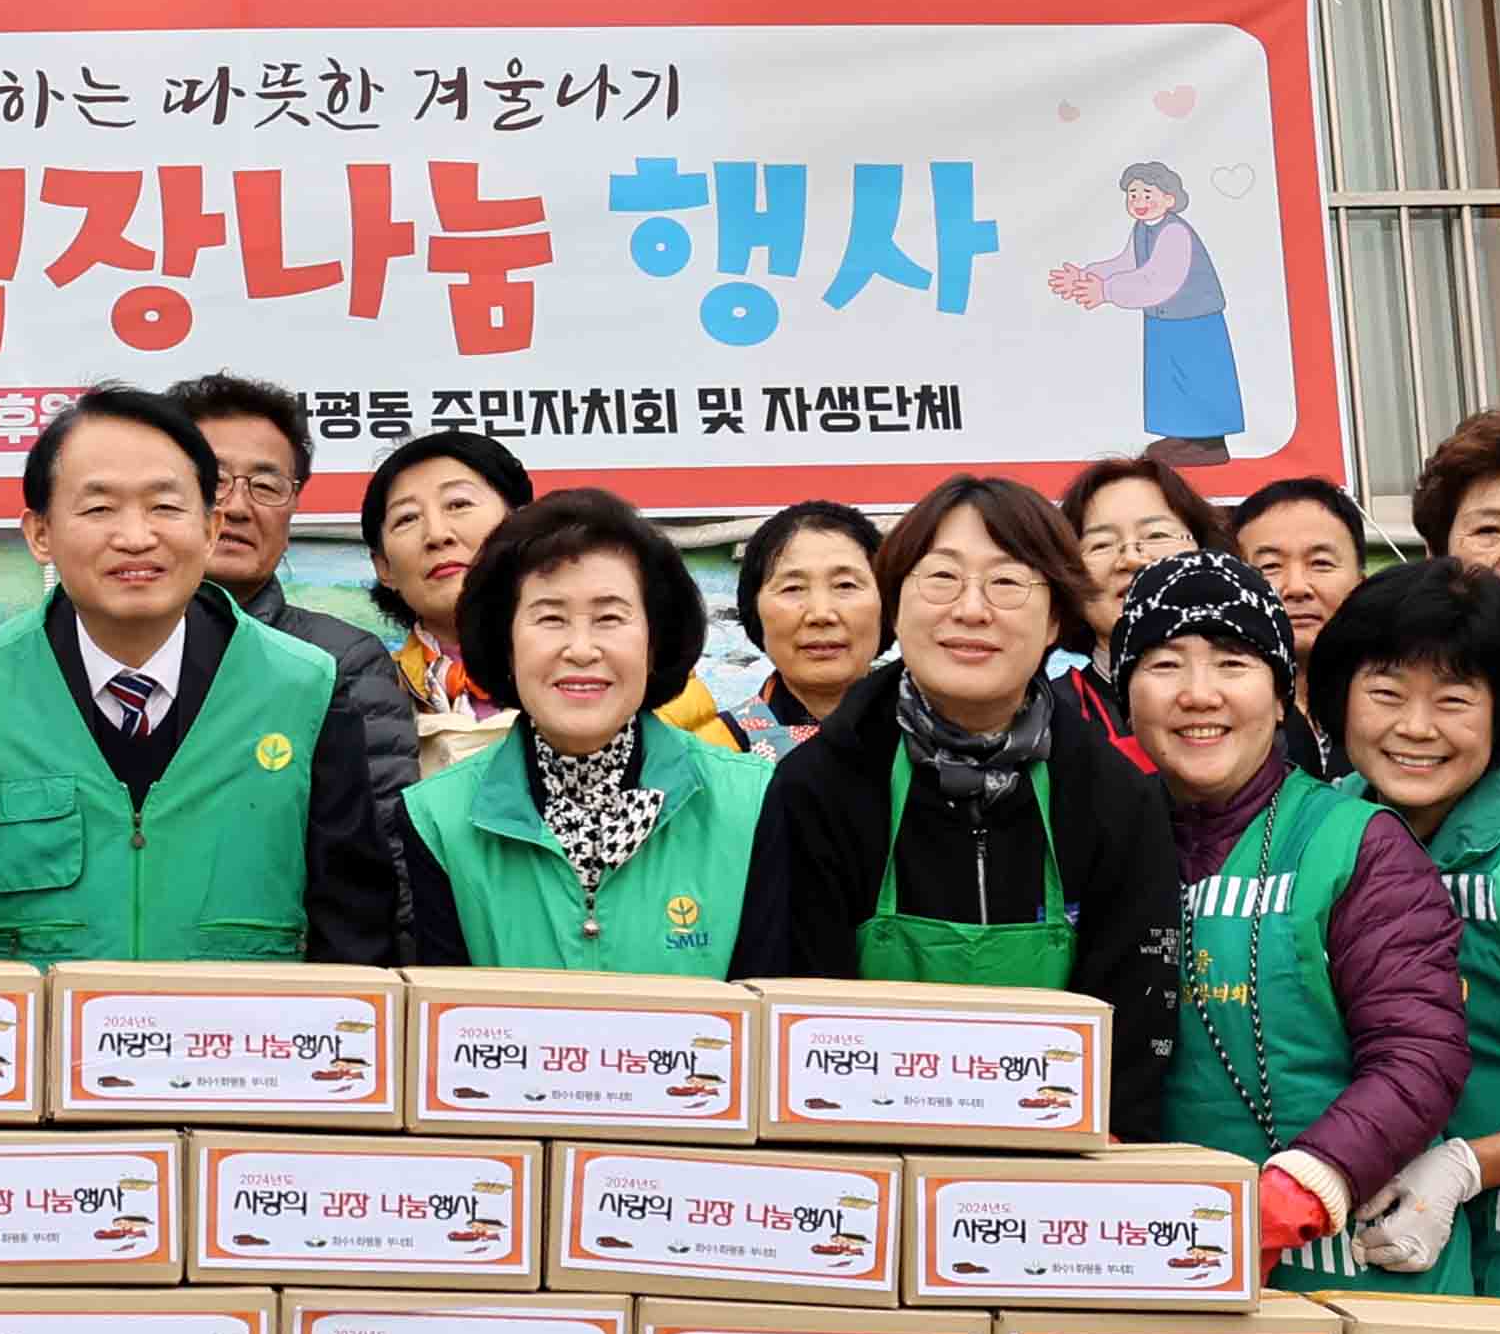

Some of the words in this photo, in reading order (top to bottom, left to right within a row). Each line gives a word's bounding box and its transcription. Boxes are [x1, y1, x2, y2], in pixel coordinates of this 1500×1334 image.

[163, 57, 385, 131] 따뜻한
[414, 57, 681, 131] 겨울나기
[608, 157, 1001, 348] 행사
[431, 388, 678, 438] 주민자치회
[697, 386, 746, 435] 및
[761, 384, 963, 434] 자생단체
[98, 1032, 173, 1059] 사랑의
[184, 1033, 235, 1060] 김장
[453, 1043, 528, 1071] 사랑의
[539, 1046, 591, 1074] 김장
[805, 1049, 880, 1077] 사랑의
[891, 1052, 942, 1080] 김장
[952, 1218, 1027, 1246] 사랑의
[1038, 1219, 1090, 1247] 김장
